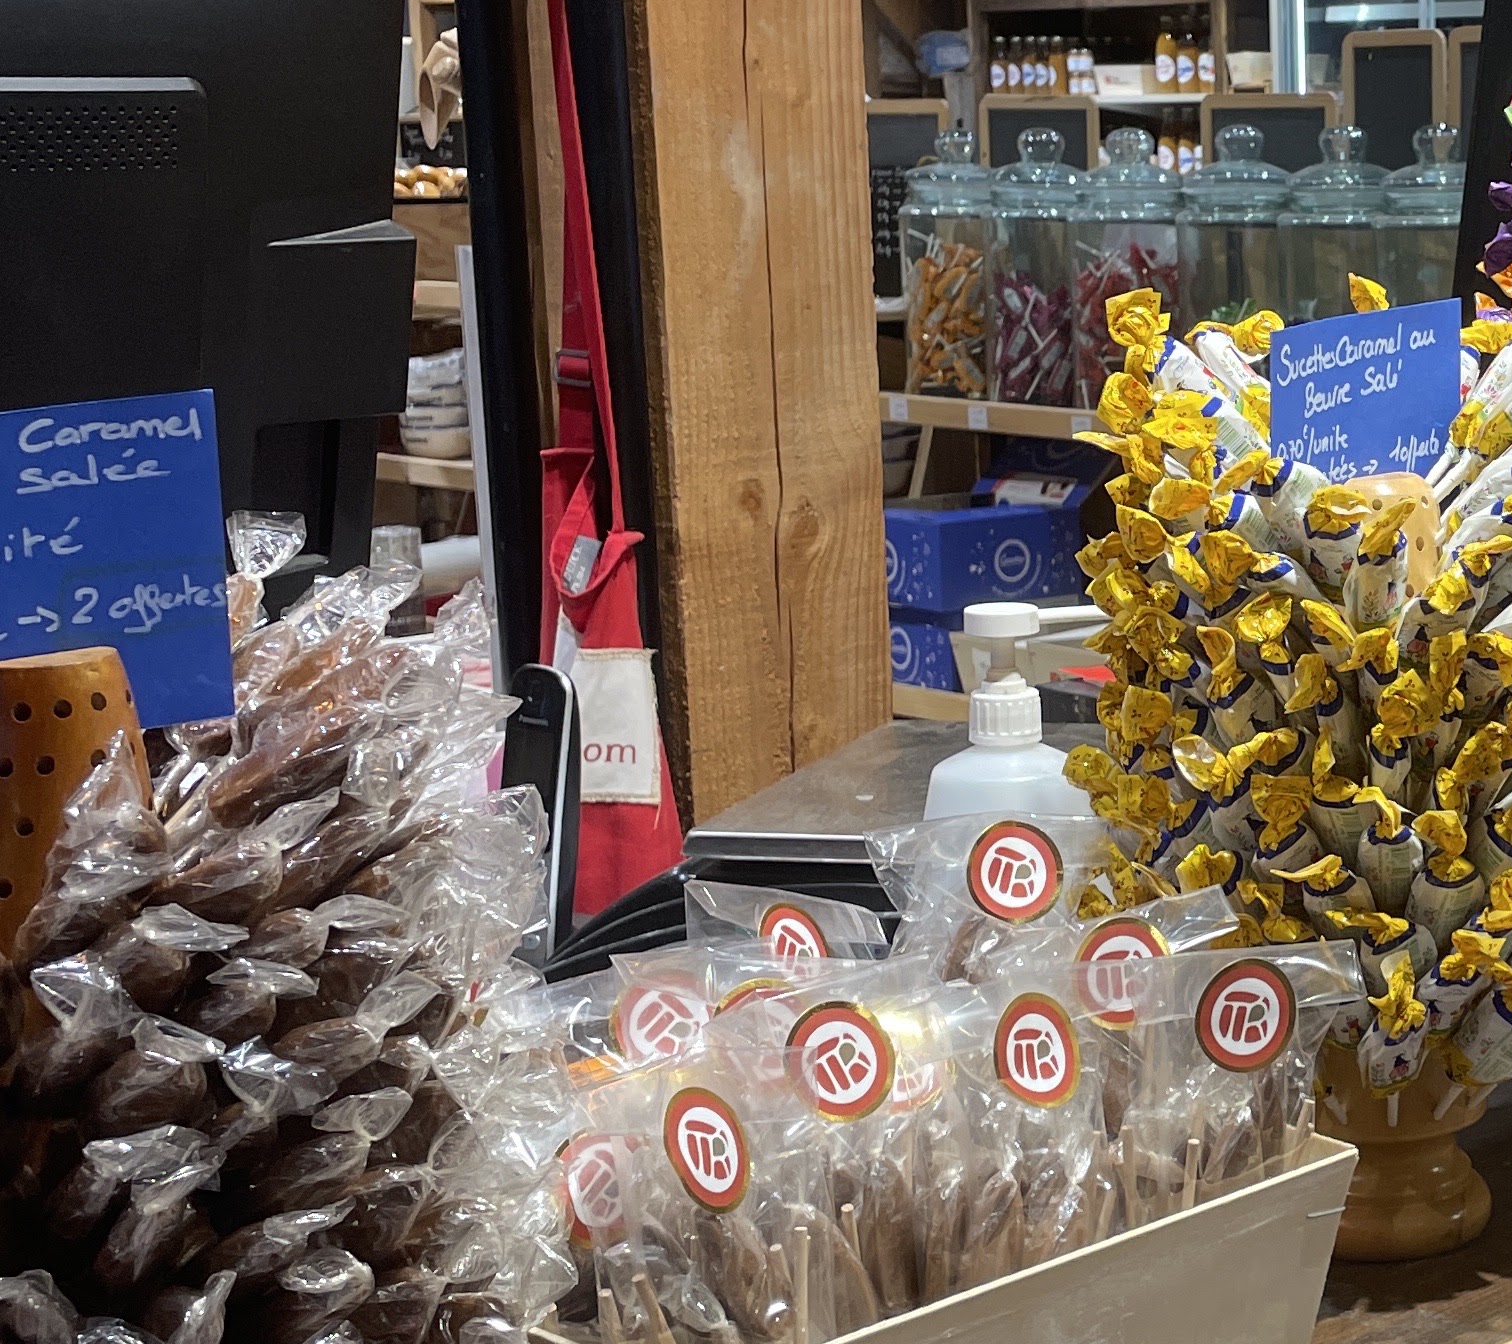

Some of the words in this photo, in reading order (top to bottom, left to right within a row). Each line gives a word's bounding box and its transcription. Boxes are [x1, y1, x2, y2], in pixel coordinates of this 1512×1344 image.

[1409, 328, 1436, 350] au
[19, 408, 203, 453] Caramel
[71, 587, 99, 625] 2
